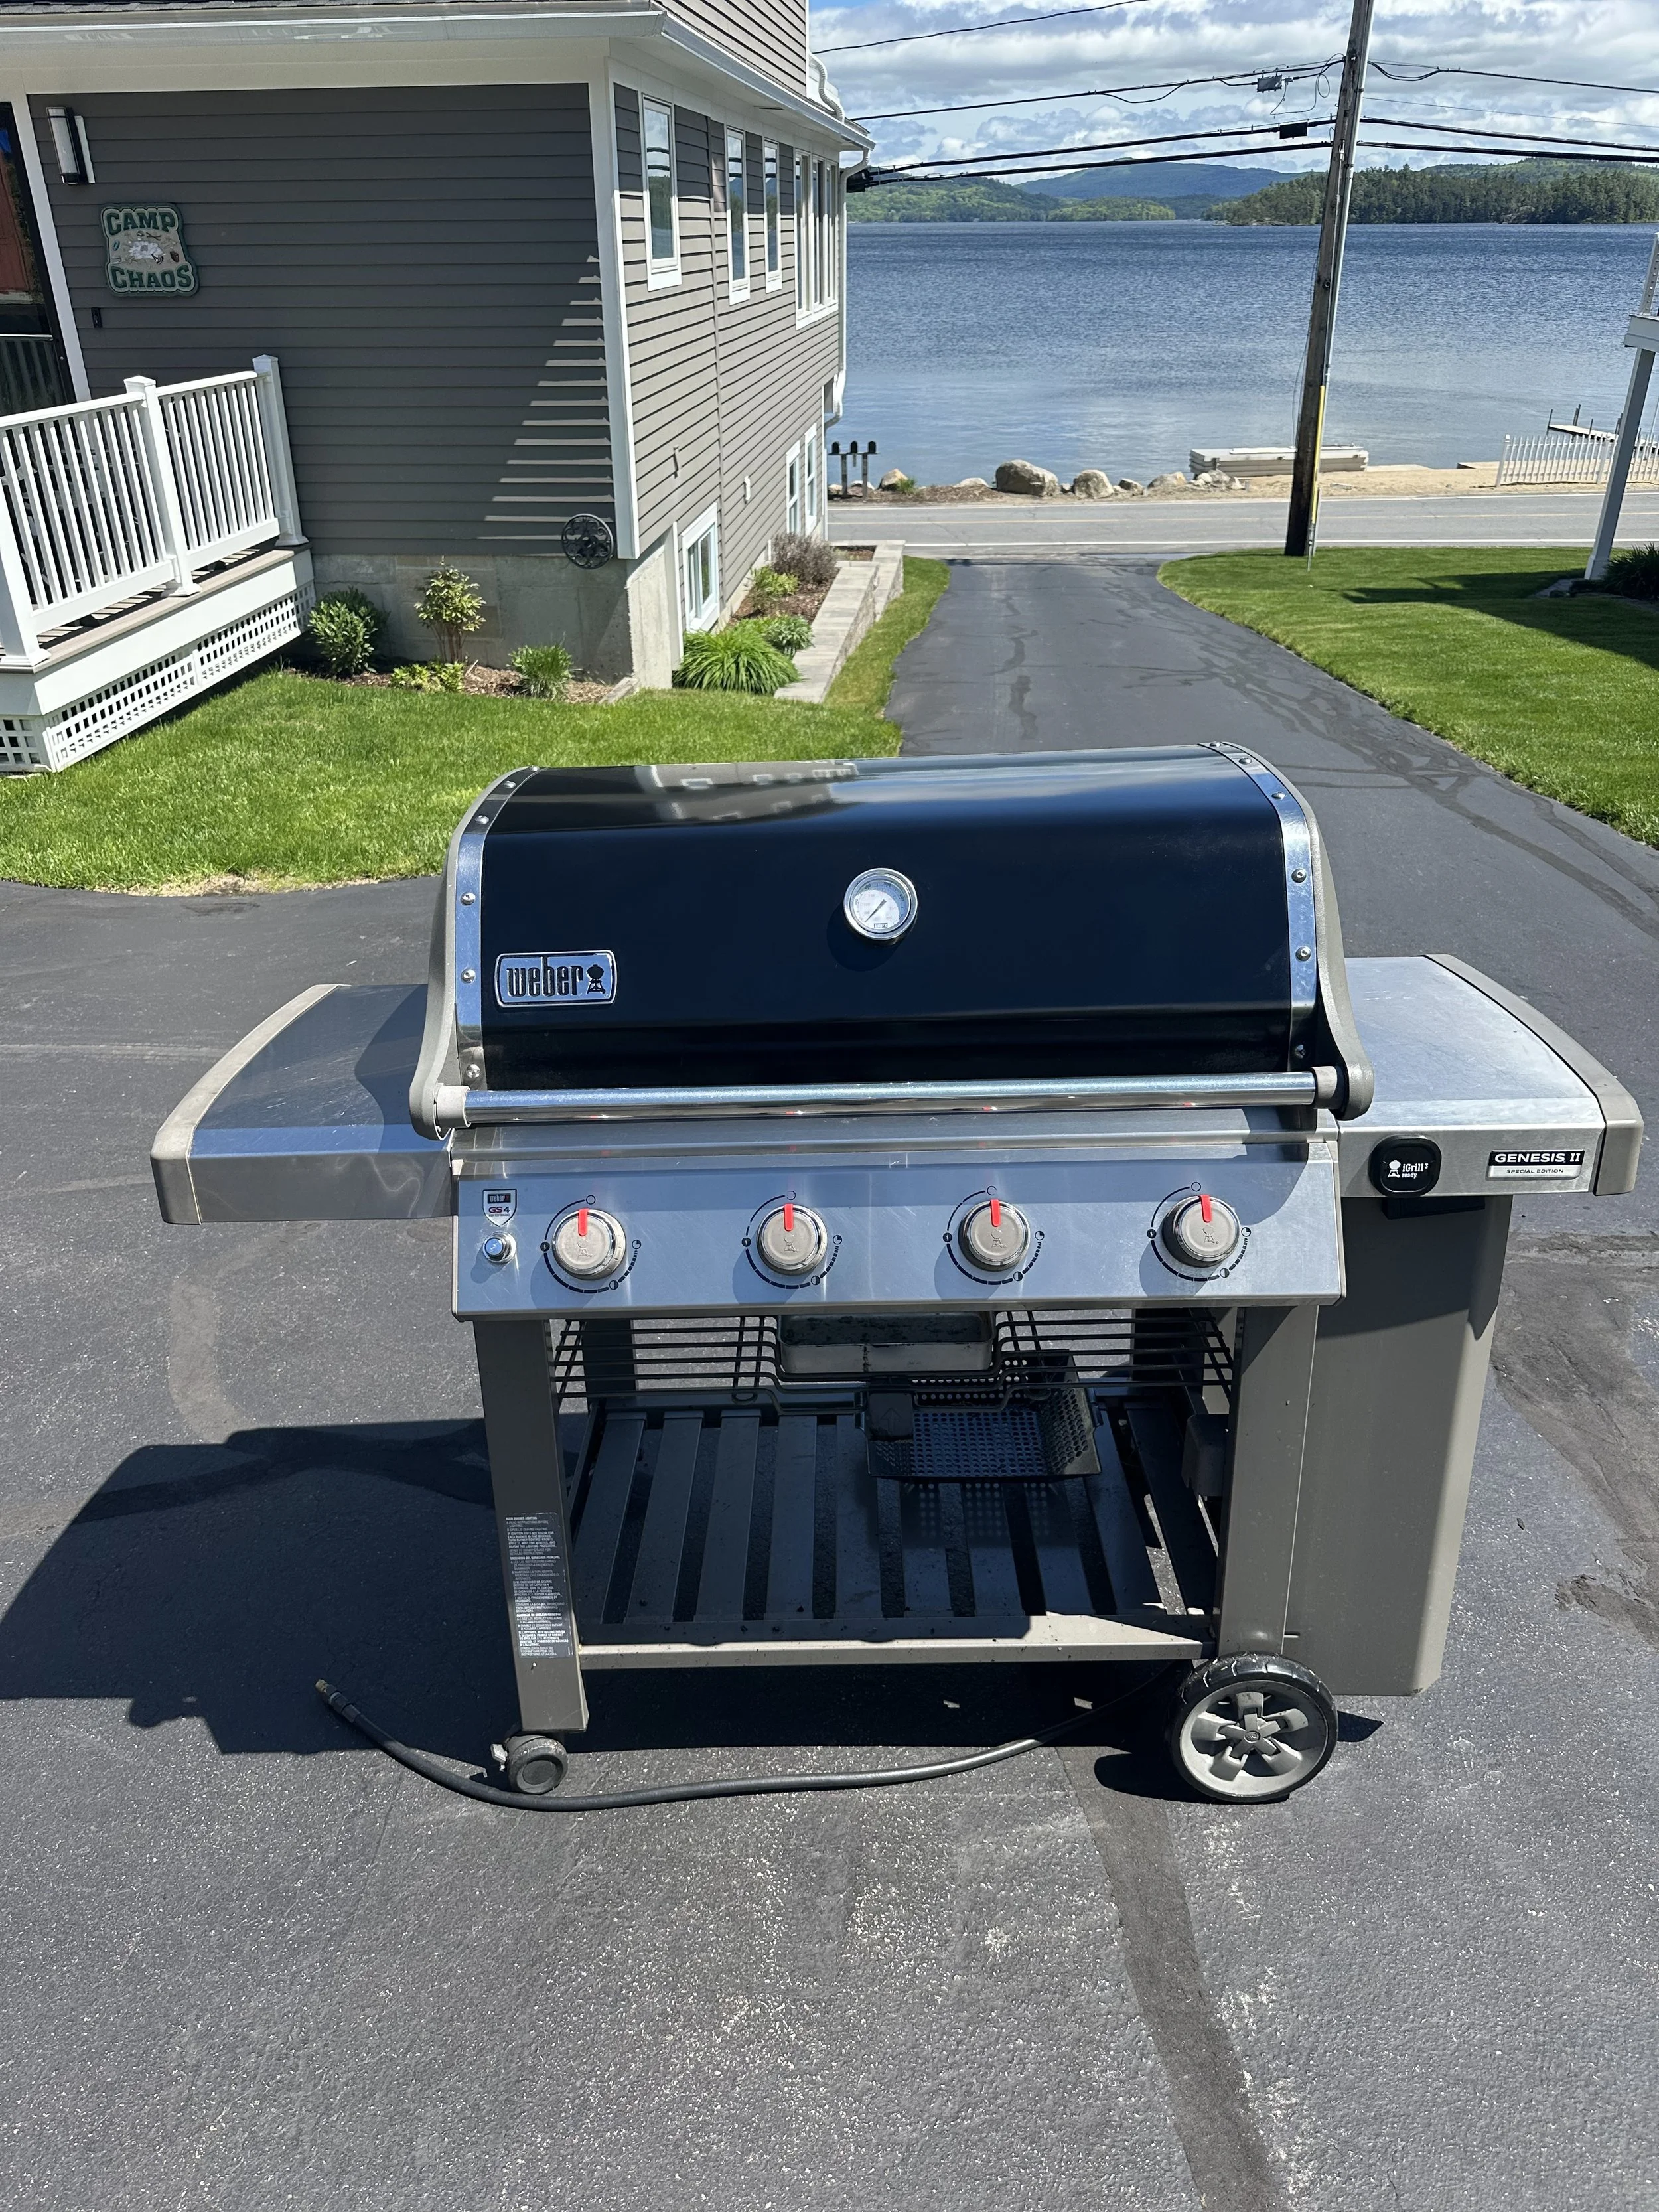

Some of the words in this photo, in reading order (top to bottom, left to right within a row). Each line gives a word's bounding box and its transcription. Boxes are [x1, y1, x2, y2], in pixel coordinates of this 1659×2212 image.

[106, 212, 175, 236] CAMP
[110, 265, 191, 289] CHAOS
[506, 956, 584, 997] weber
[1494, 1153, 1565, 1163] GENESIS
[1569, 1153, 1581, 1162] II
